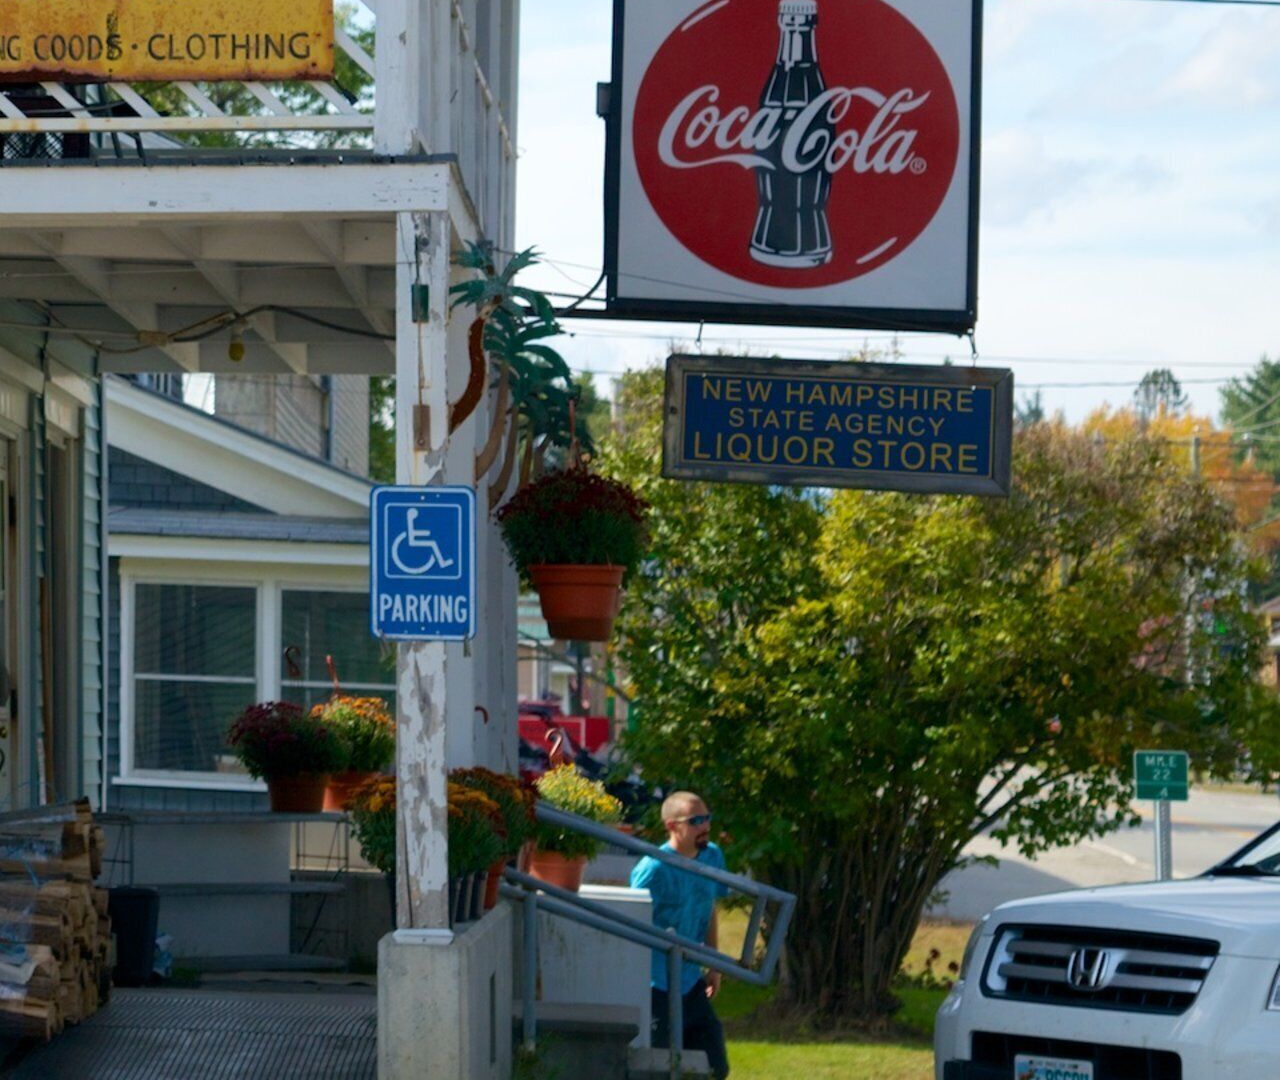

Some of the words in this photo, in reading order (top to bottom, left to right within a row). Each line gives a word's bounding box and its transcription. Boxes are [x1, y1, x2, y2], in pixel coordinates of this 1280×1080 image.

[147, 33, 312, 61] CLOTHING
[656, 84, 932, 174] Coca-Cola
[702, 378, 774, 403] NEW
[785, 382, 975, 413] HAMPSHIRE
[728, 407, 815, 432] STATE
[824, 413, 945, 437] AGENCY
[693, 431, 836, 466] LIQUOR
[851, 438, 979, 473] STORE
[379, 593, 468, 624] PARKING
